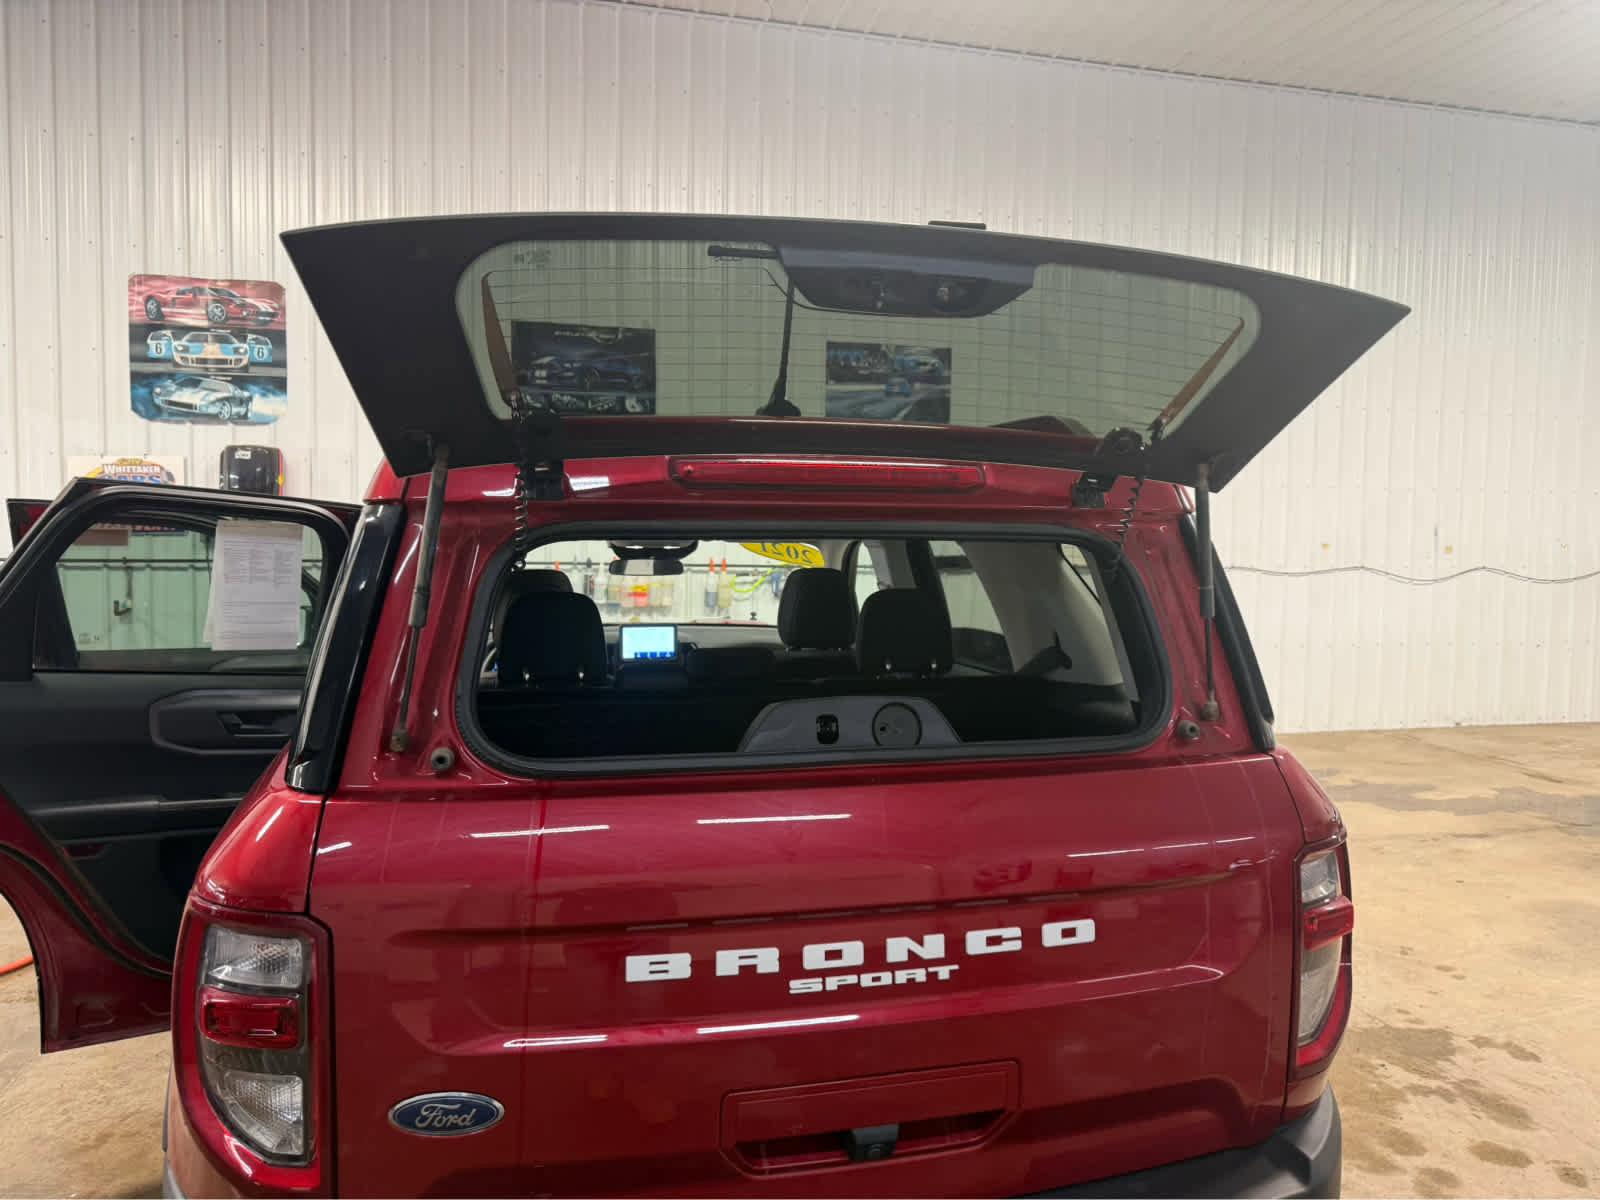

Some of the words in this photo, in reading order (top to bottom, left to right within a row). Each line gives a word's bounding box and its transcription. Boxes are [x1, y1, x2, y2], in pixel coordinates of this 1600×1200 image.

[154, 342, 163, 355] 6
[256, 346, 265, 359] 6
[625, 918, 1096, 982] BRONCO
[788, 964, 960, 994] SPORT
[415, 1103, 477, 1128] Ford
